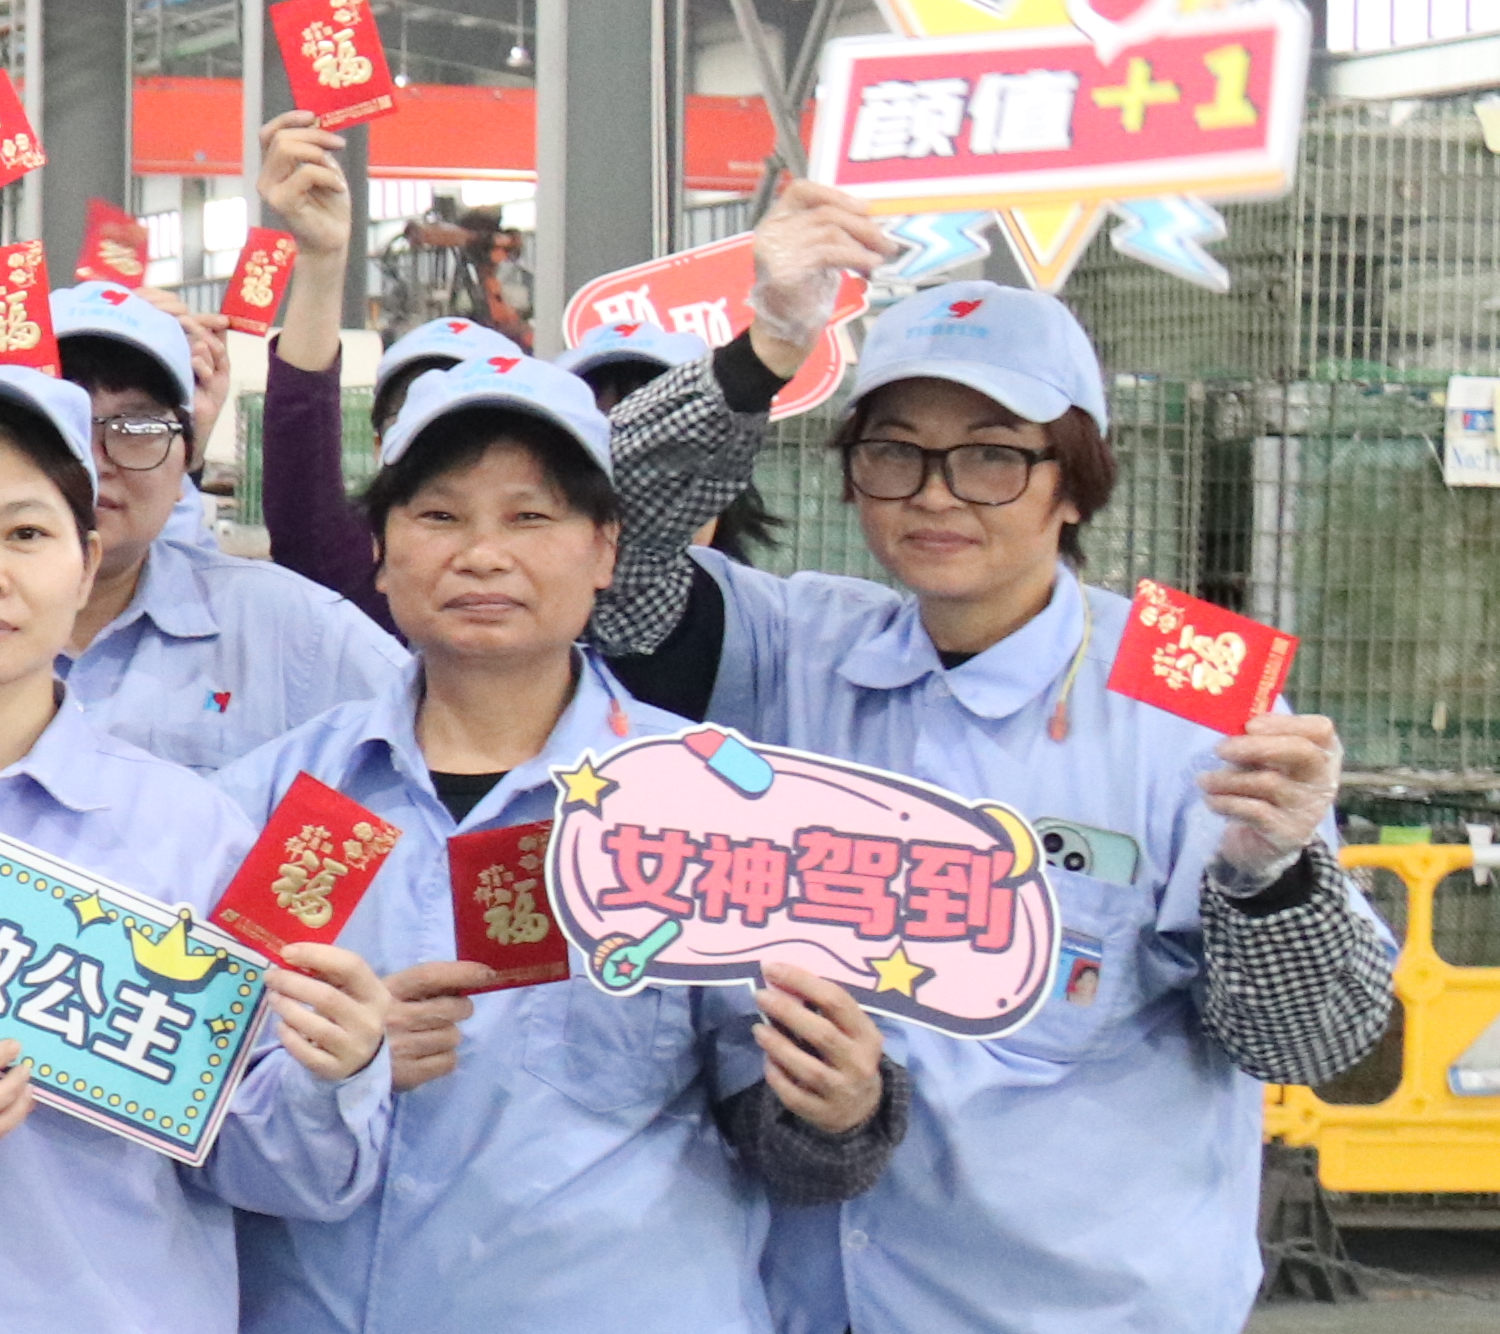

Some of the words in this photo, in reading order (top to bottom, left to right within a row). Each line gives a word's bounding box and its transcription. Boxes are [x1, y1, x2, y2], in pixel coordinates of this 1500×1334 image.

[312, 27, 374, 89] 福
[270, 848, 349, 929] 福
[482, 877, 549, 946] 福
[599, 823, 1018, 951] 女神驾到
